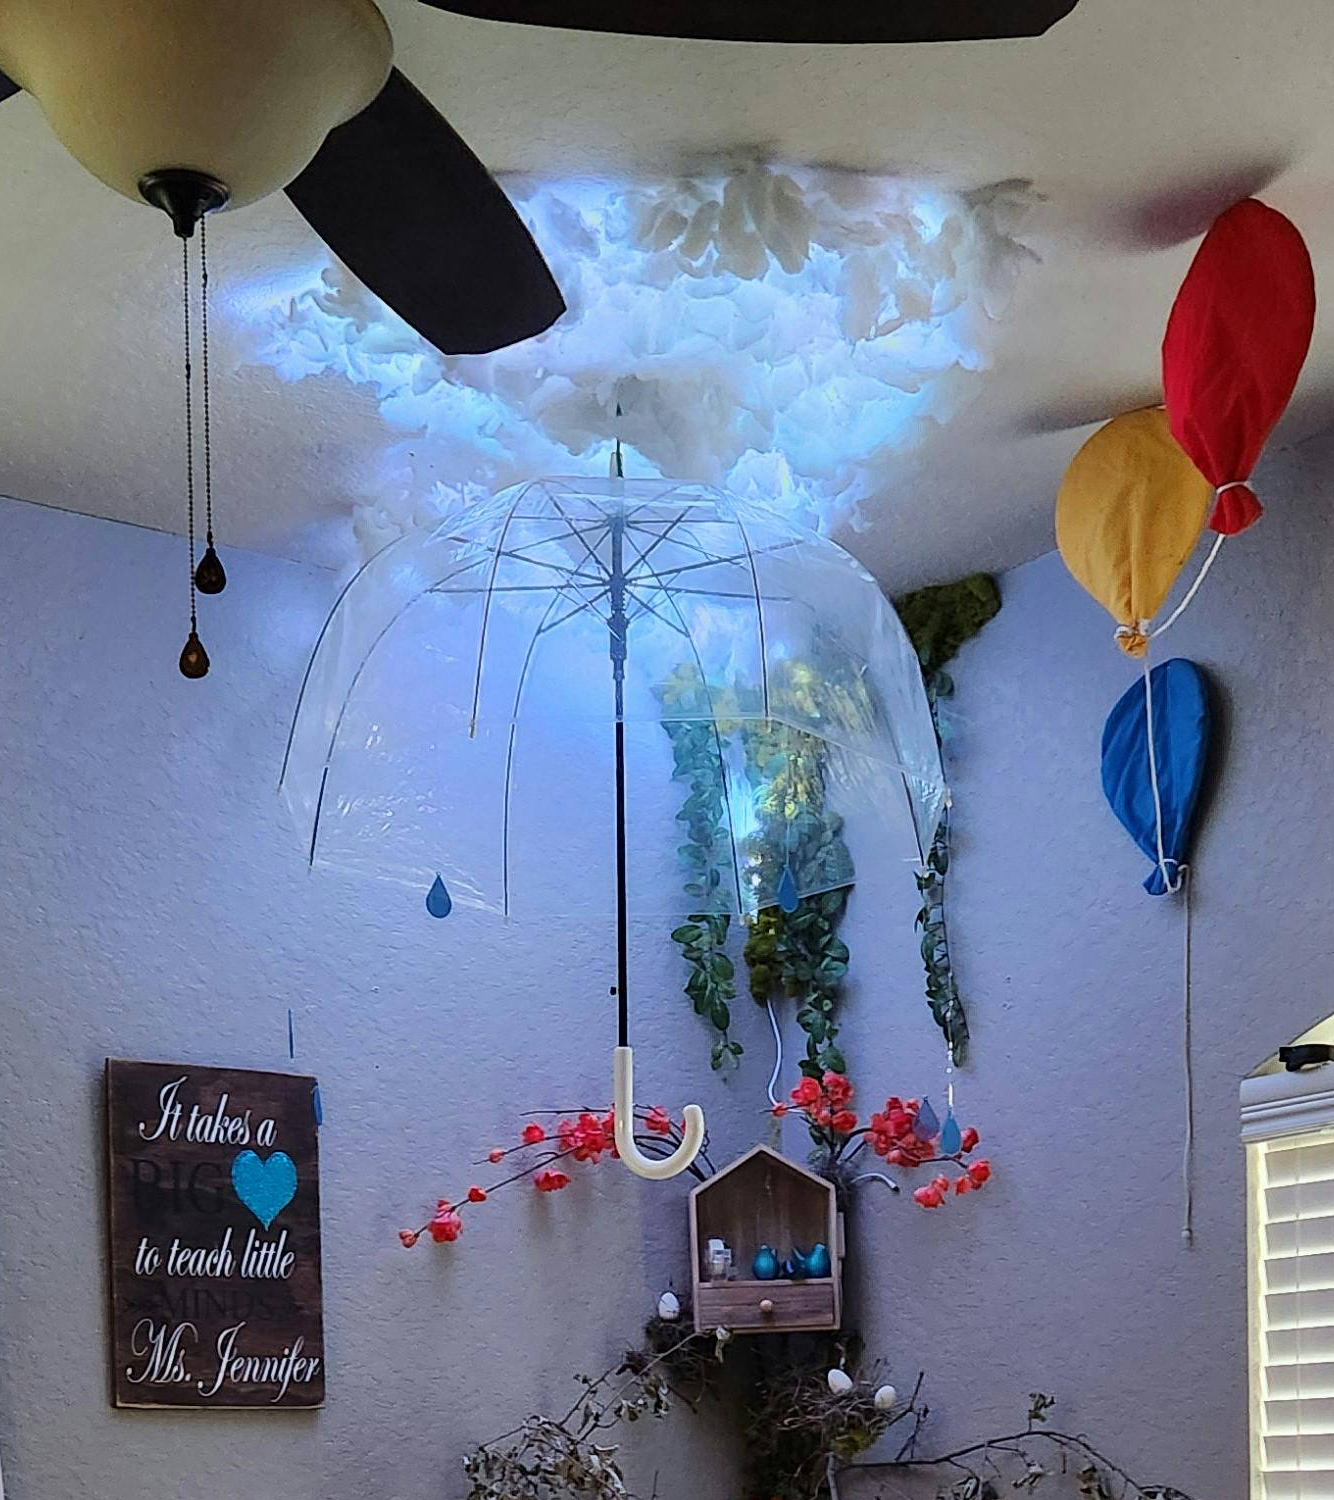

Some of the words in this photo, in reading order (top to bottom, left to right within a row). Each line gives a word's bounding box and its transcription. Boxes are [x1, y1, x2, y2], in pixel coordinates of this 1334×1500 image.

[139, 1076, 183, 1142] It
[187, 1094, 251, 1145] takes
[257, 1118, 276, 1147] a
[131, 1157, 224, 1214] BIG
[134, 1236, 161, 1275] to
[168, 1227, 236, 1278] teach
[241, 1230, 295, 1280] little
[161, 1286, 271, 1320] MINDS
[126, 1318, 198, 1383] Ms.
[198, 1321, 320, 1403] Jennifer
